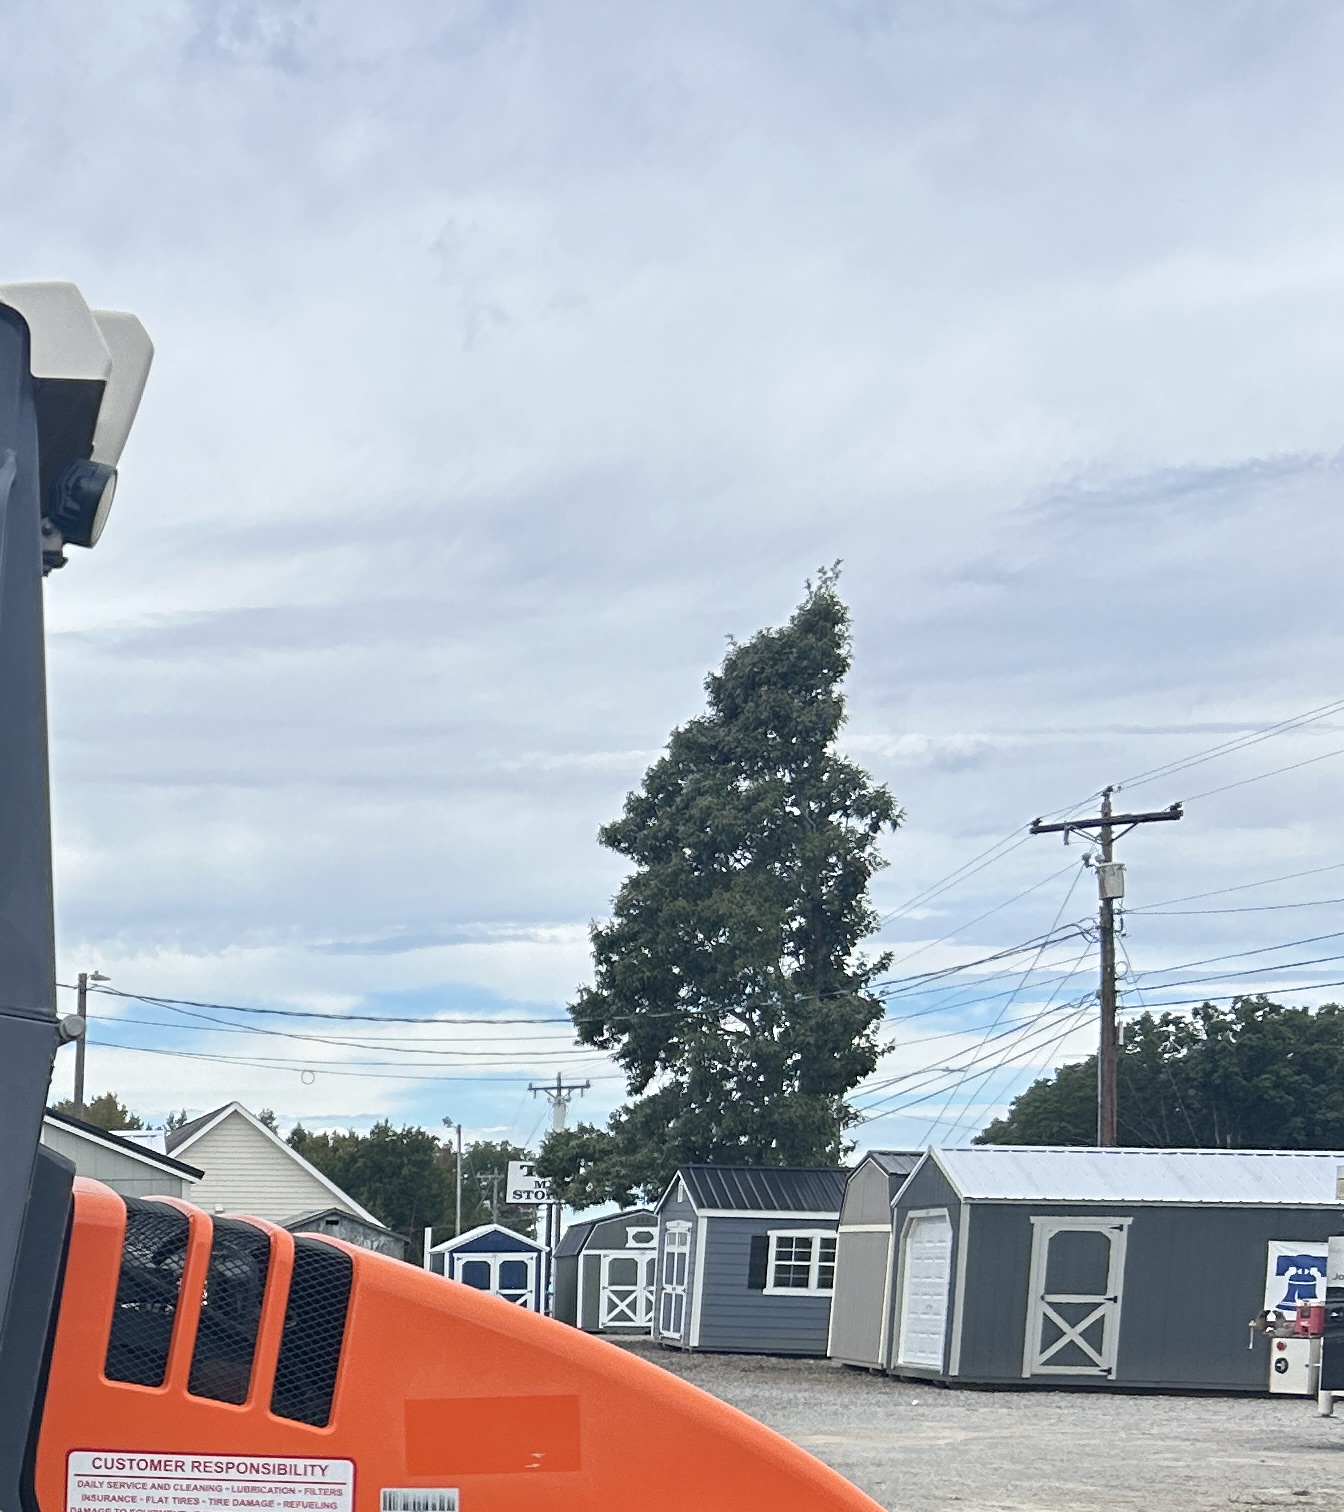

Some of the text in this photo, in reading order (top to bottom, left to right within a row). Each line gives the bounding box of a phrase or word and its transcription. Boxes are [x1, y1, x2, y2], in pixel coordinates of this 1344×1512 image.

[92, 1457, 330, 1477] CUSTOMER RESPONSIBILITY
[77, 1480, 343, 1496] DAILY SERVICE AND CLEANING LUBRICATION FILTERS
[81, 1493, 338, 1510] INSURANCE FLAT TIRES TIRE DAMAGE REFUELING
